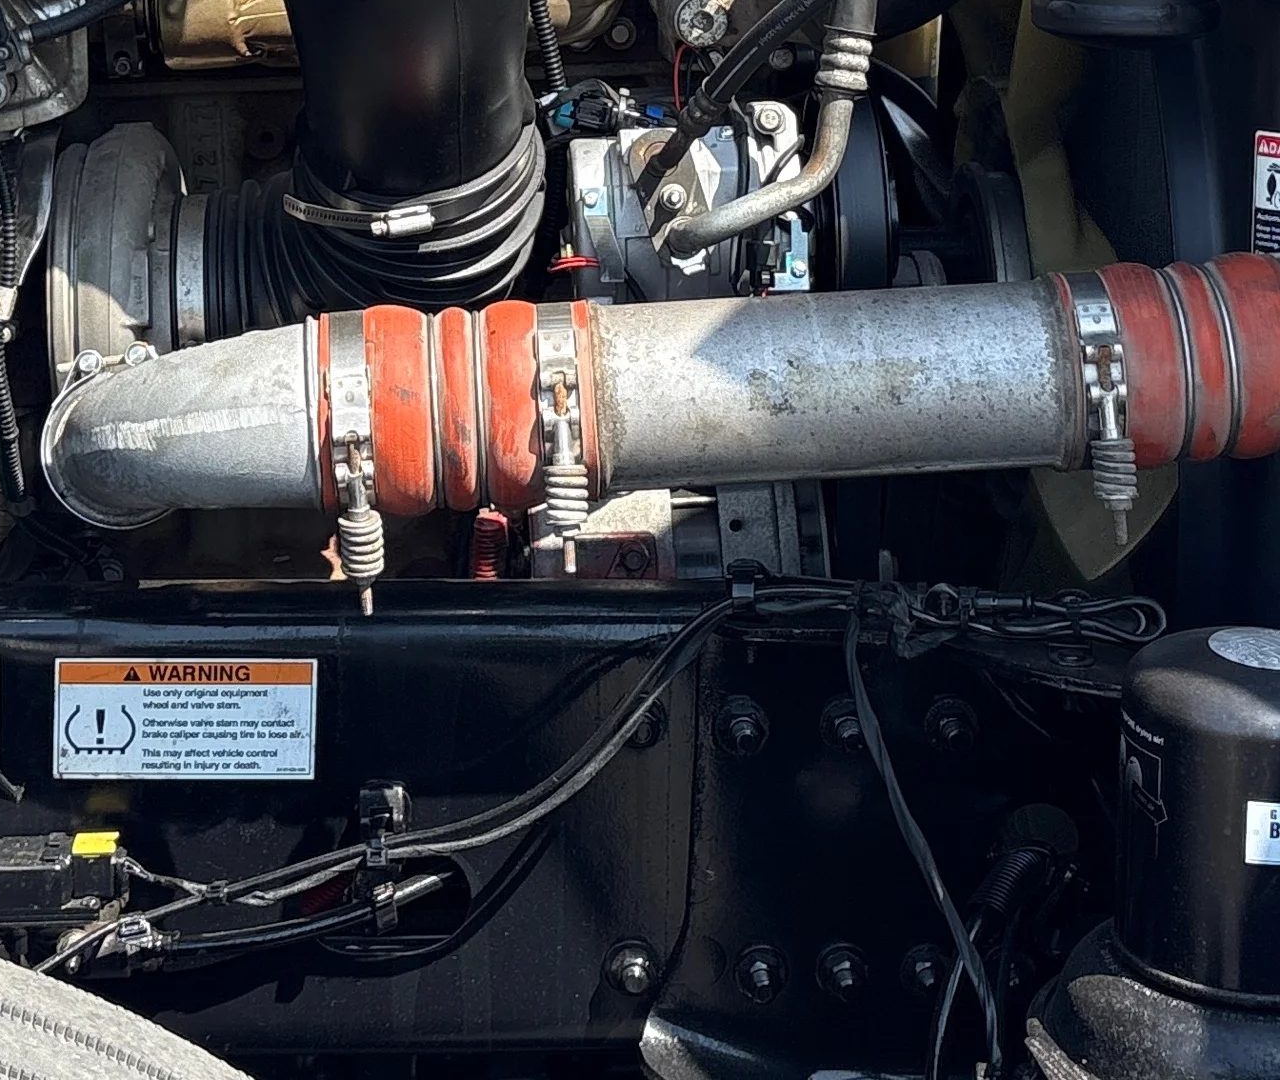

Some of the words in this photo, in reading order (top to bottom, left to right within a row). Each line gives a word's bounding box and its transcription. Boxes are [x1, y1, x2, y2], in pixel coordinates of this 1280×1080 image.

[1256, 223, 1271, 232] Keep
[148, 665, 251, 681] WARNING
[143, 688, 161, 697] Use
[163, 688, 183, 700] only
[184, 688, 219, 700] original
[221, 688, 268, 699] equipment
[142, 700, 169, 709] wheel
[170, 700, 189, 709] and
[190, 700, 215, 709] valve
[216, 701, 241, 709] stem.
[142, 717, 189, 727] Otherwise
[190, 718, 215, 727] valve
[216, 718, 239, 727] stem
[240, 719, 259, 730] may
[260, 719, 295, 728] contact
[142, 730, 168, 739] brake
[169, 729, 201, 740] caliper
[202, 729, 238, 741] causing
[239, 730, 255, 739] tire
[256, 730, 266, 739] to
[268, 730, 288, 739] lose
[289, 729, 305, 739] air.
[142, 748, 161, 758] This
[162, 750, 183, 760] may
[184, 748, 210, 758] affect
[211, 748, 244, 758] vehicle
[245, 748, 278, 758] control
[141, 760, 182, 771] resulting
[183, 760, 192, 769] in
[193, 760, 220, 771] injury
[221, 762, 231, 770] or
[233, 760, 261, 770] death.
